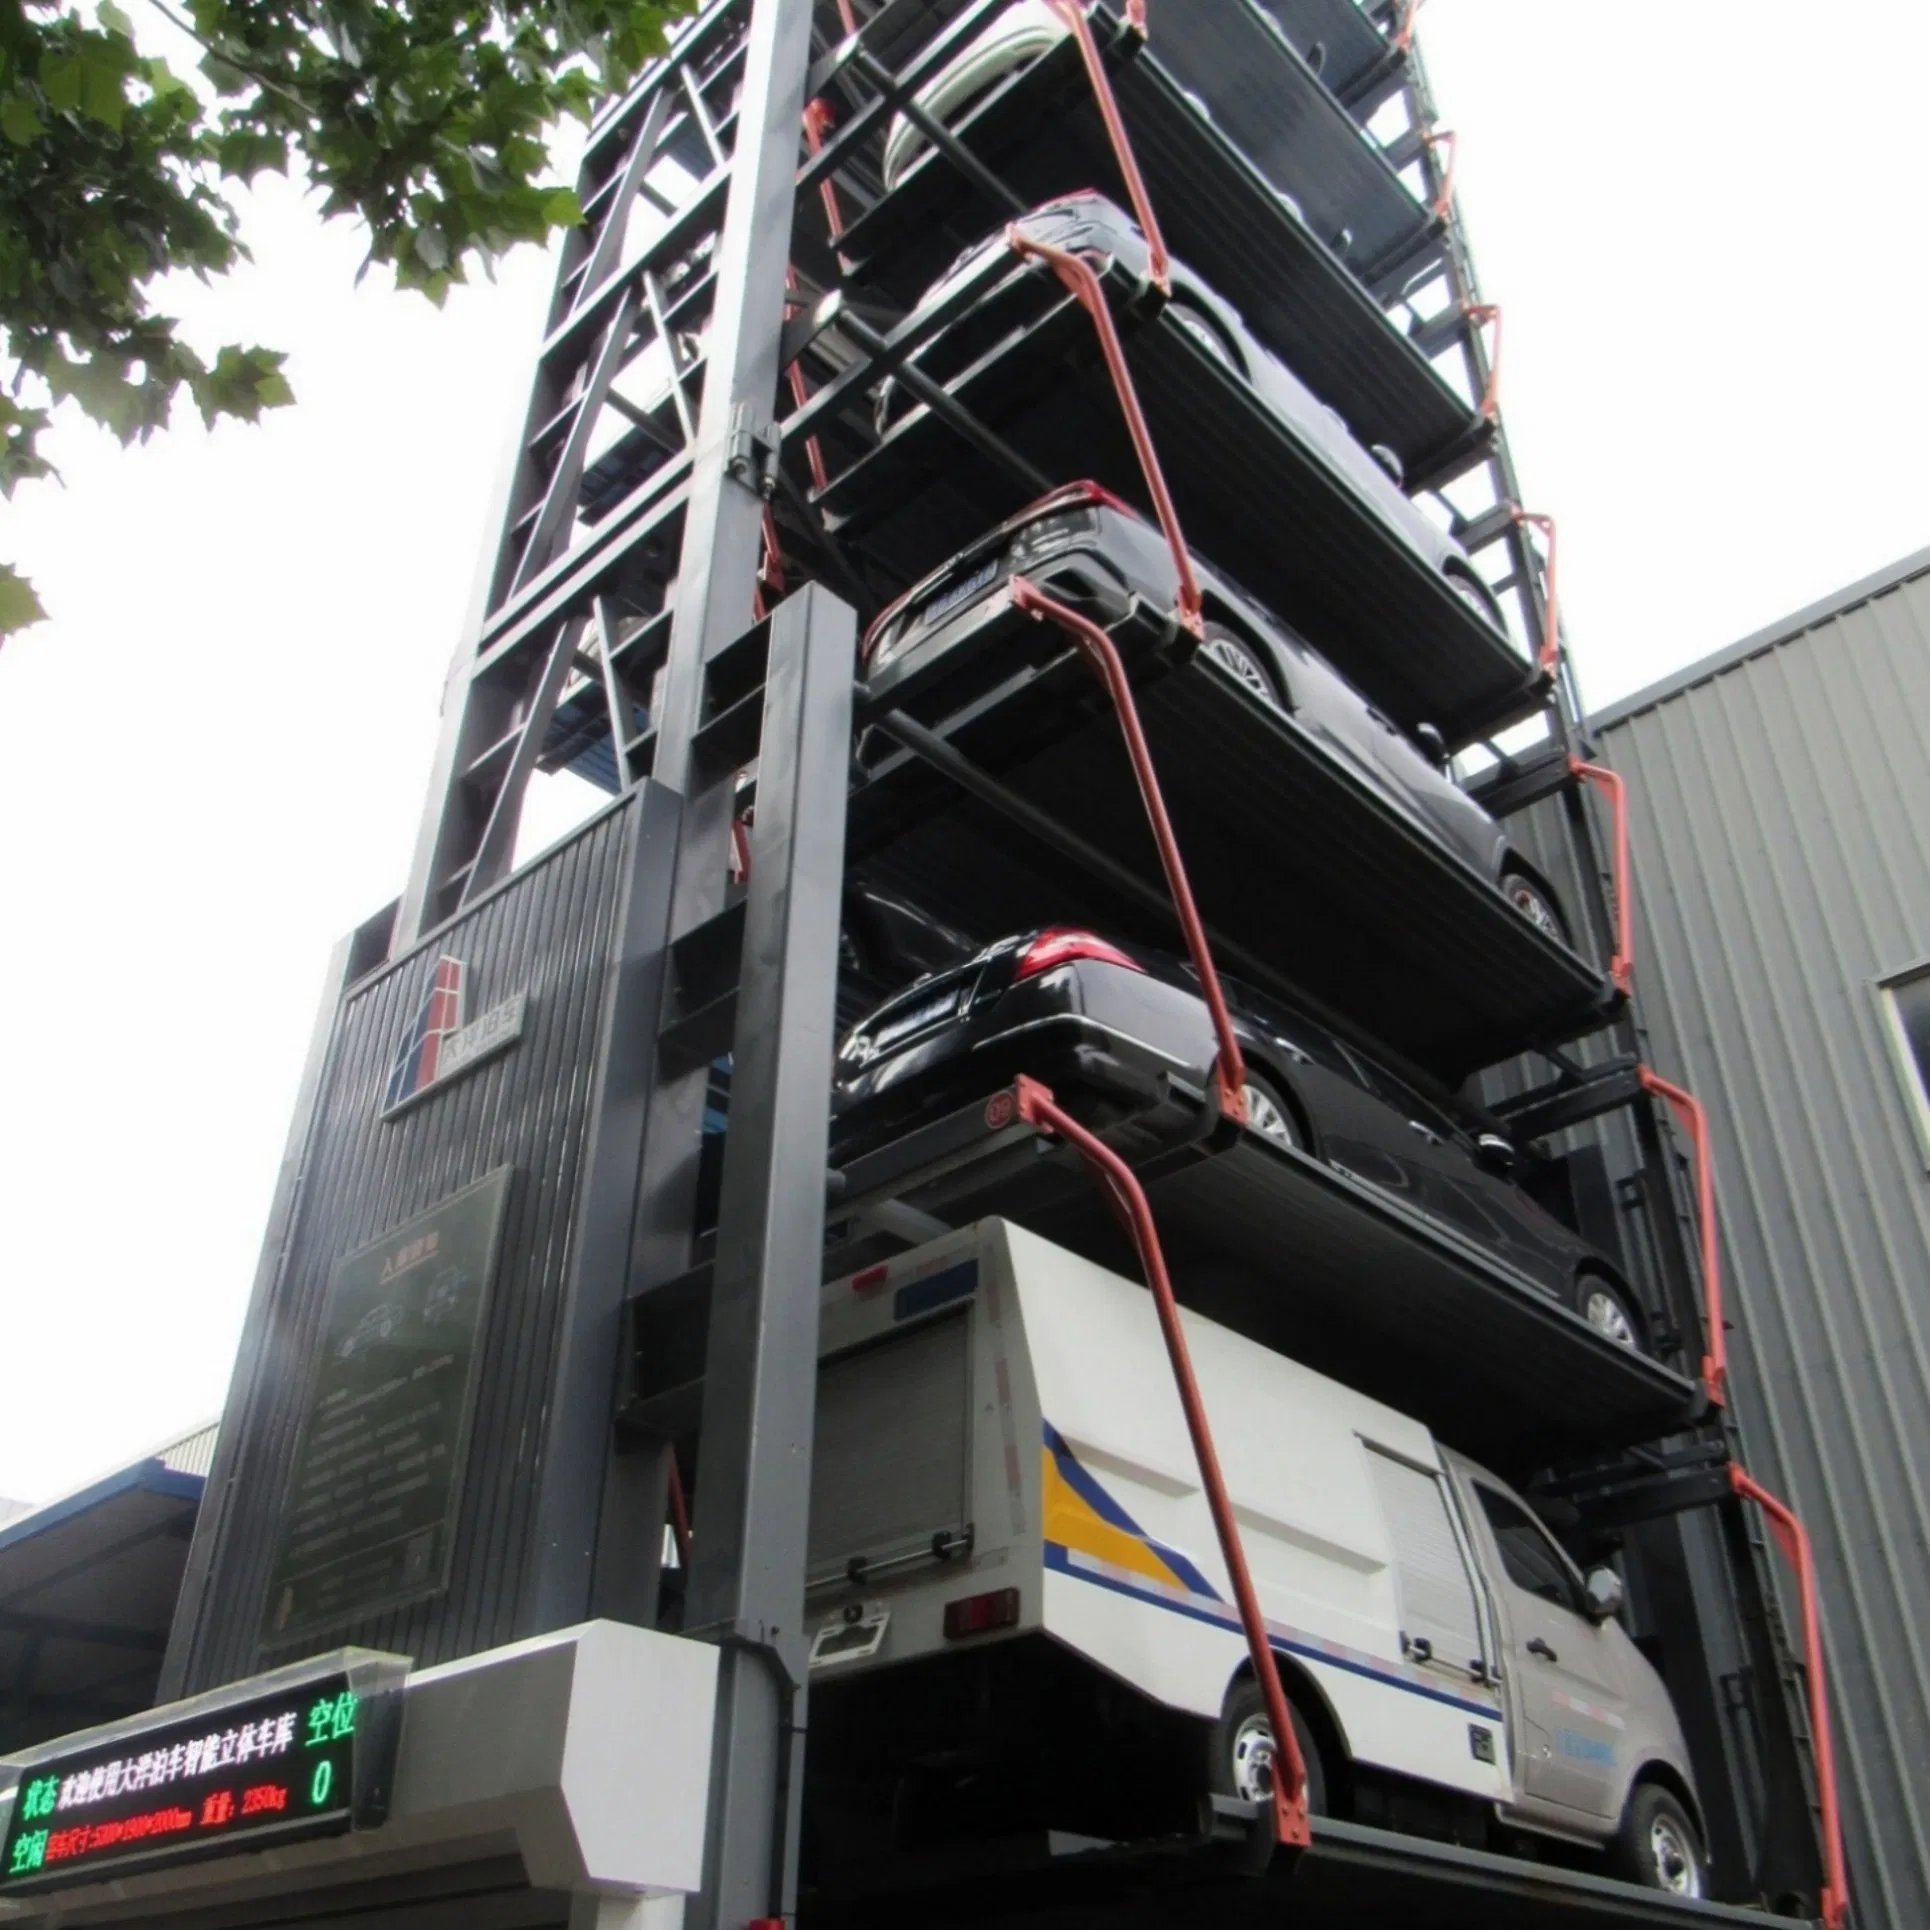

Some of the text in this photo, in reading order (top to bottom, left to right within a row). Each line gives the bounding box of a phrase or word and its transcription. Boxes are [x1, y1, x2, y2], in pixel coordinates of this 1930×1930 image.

[304, 1691, 358, 1746] 空位
[23, 1774, 59, 1820] 状态
[312, 1759, 332, 1804] 0
[9, 1828, 49, 1874] 空闲
